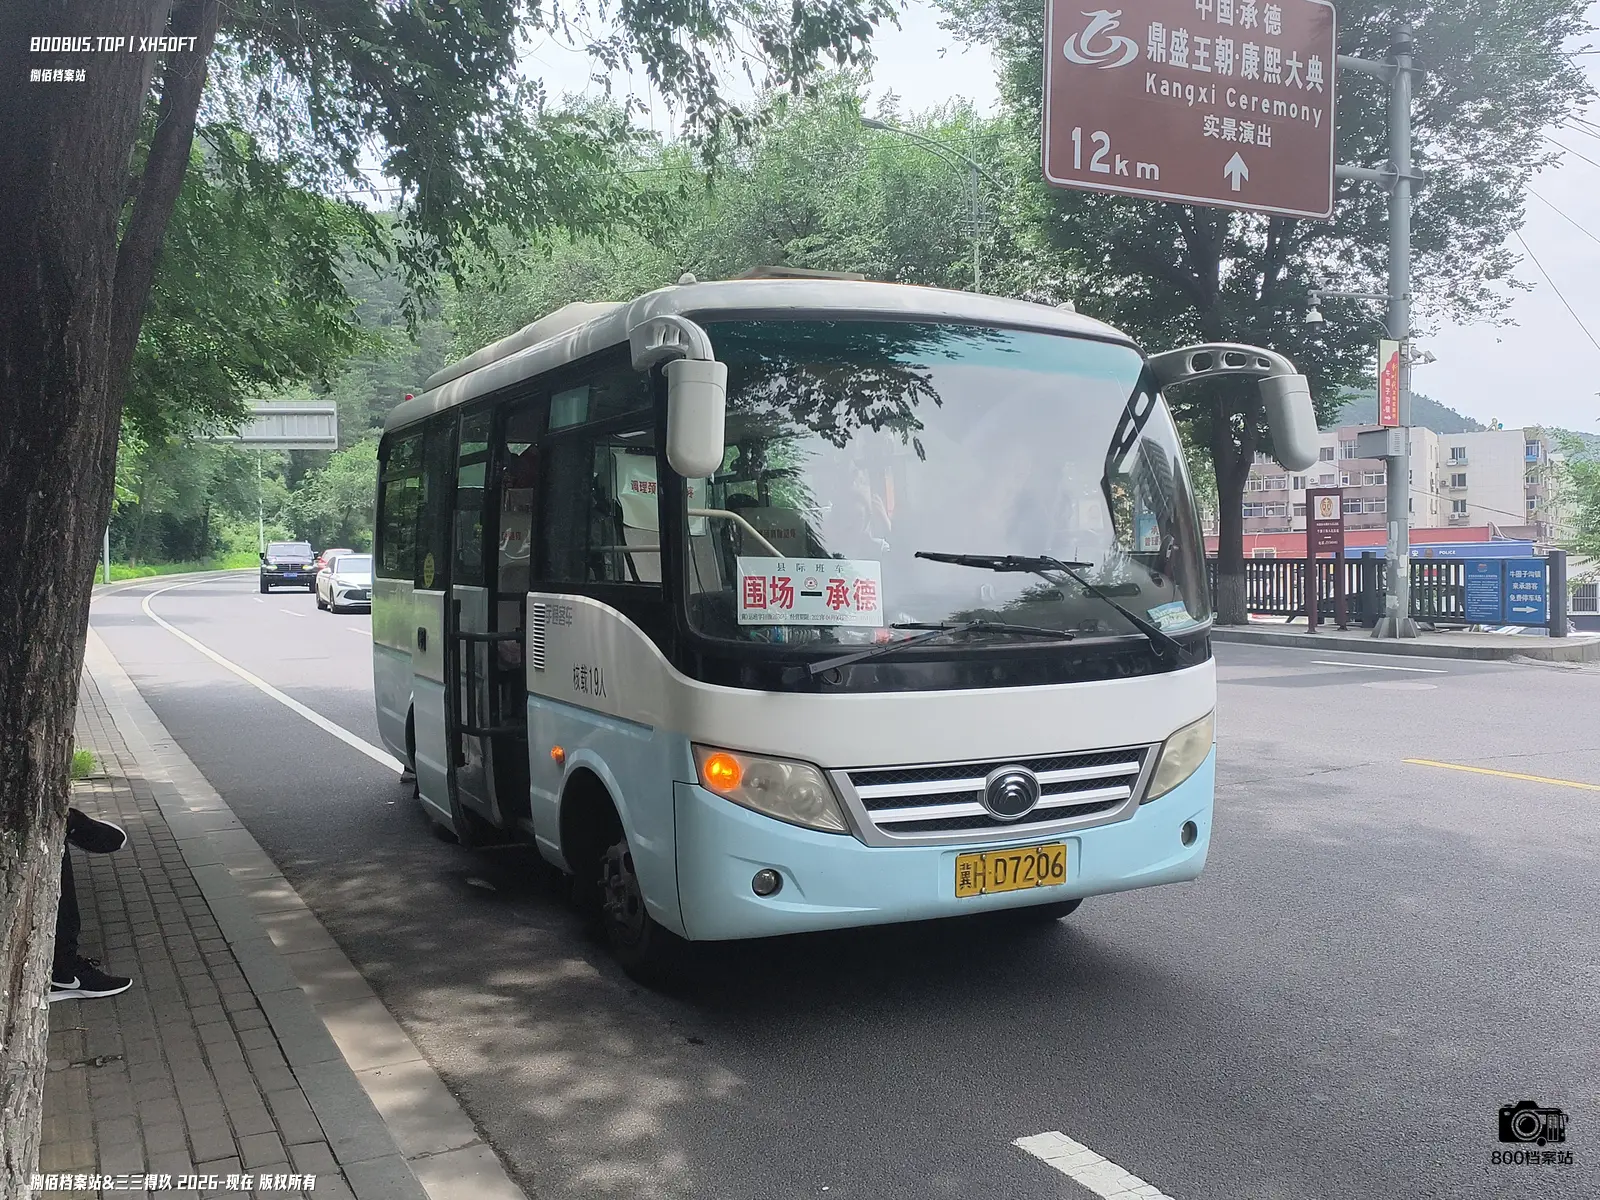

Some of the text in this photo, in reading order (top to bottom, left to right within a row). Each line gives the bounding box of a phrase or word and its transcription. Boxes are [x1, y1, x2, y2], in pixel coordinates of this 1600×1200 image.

[1147, 21, 1324, 93] 鼎盛王朝·康熙大典
[1145, 72, 1323, 128] Kangxi Ceremony
[1203, 114, 1273, 148] 实景演出
[776, 562, 844, 574] 县际班车
[572, 662, 607, 698] 核载19人
